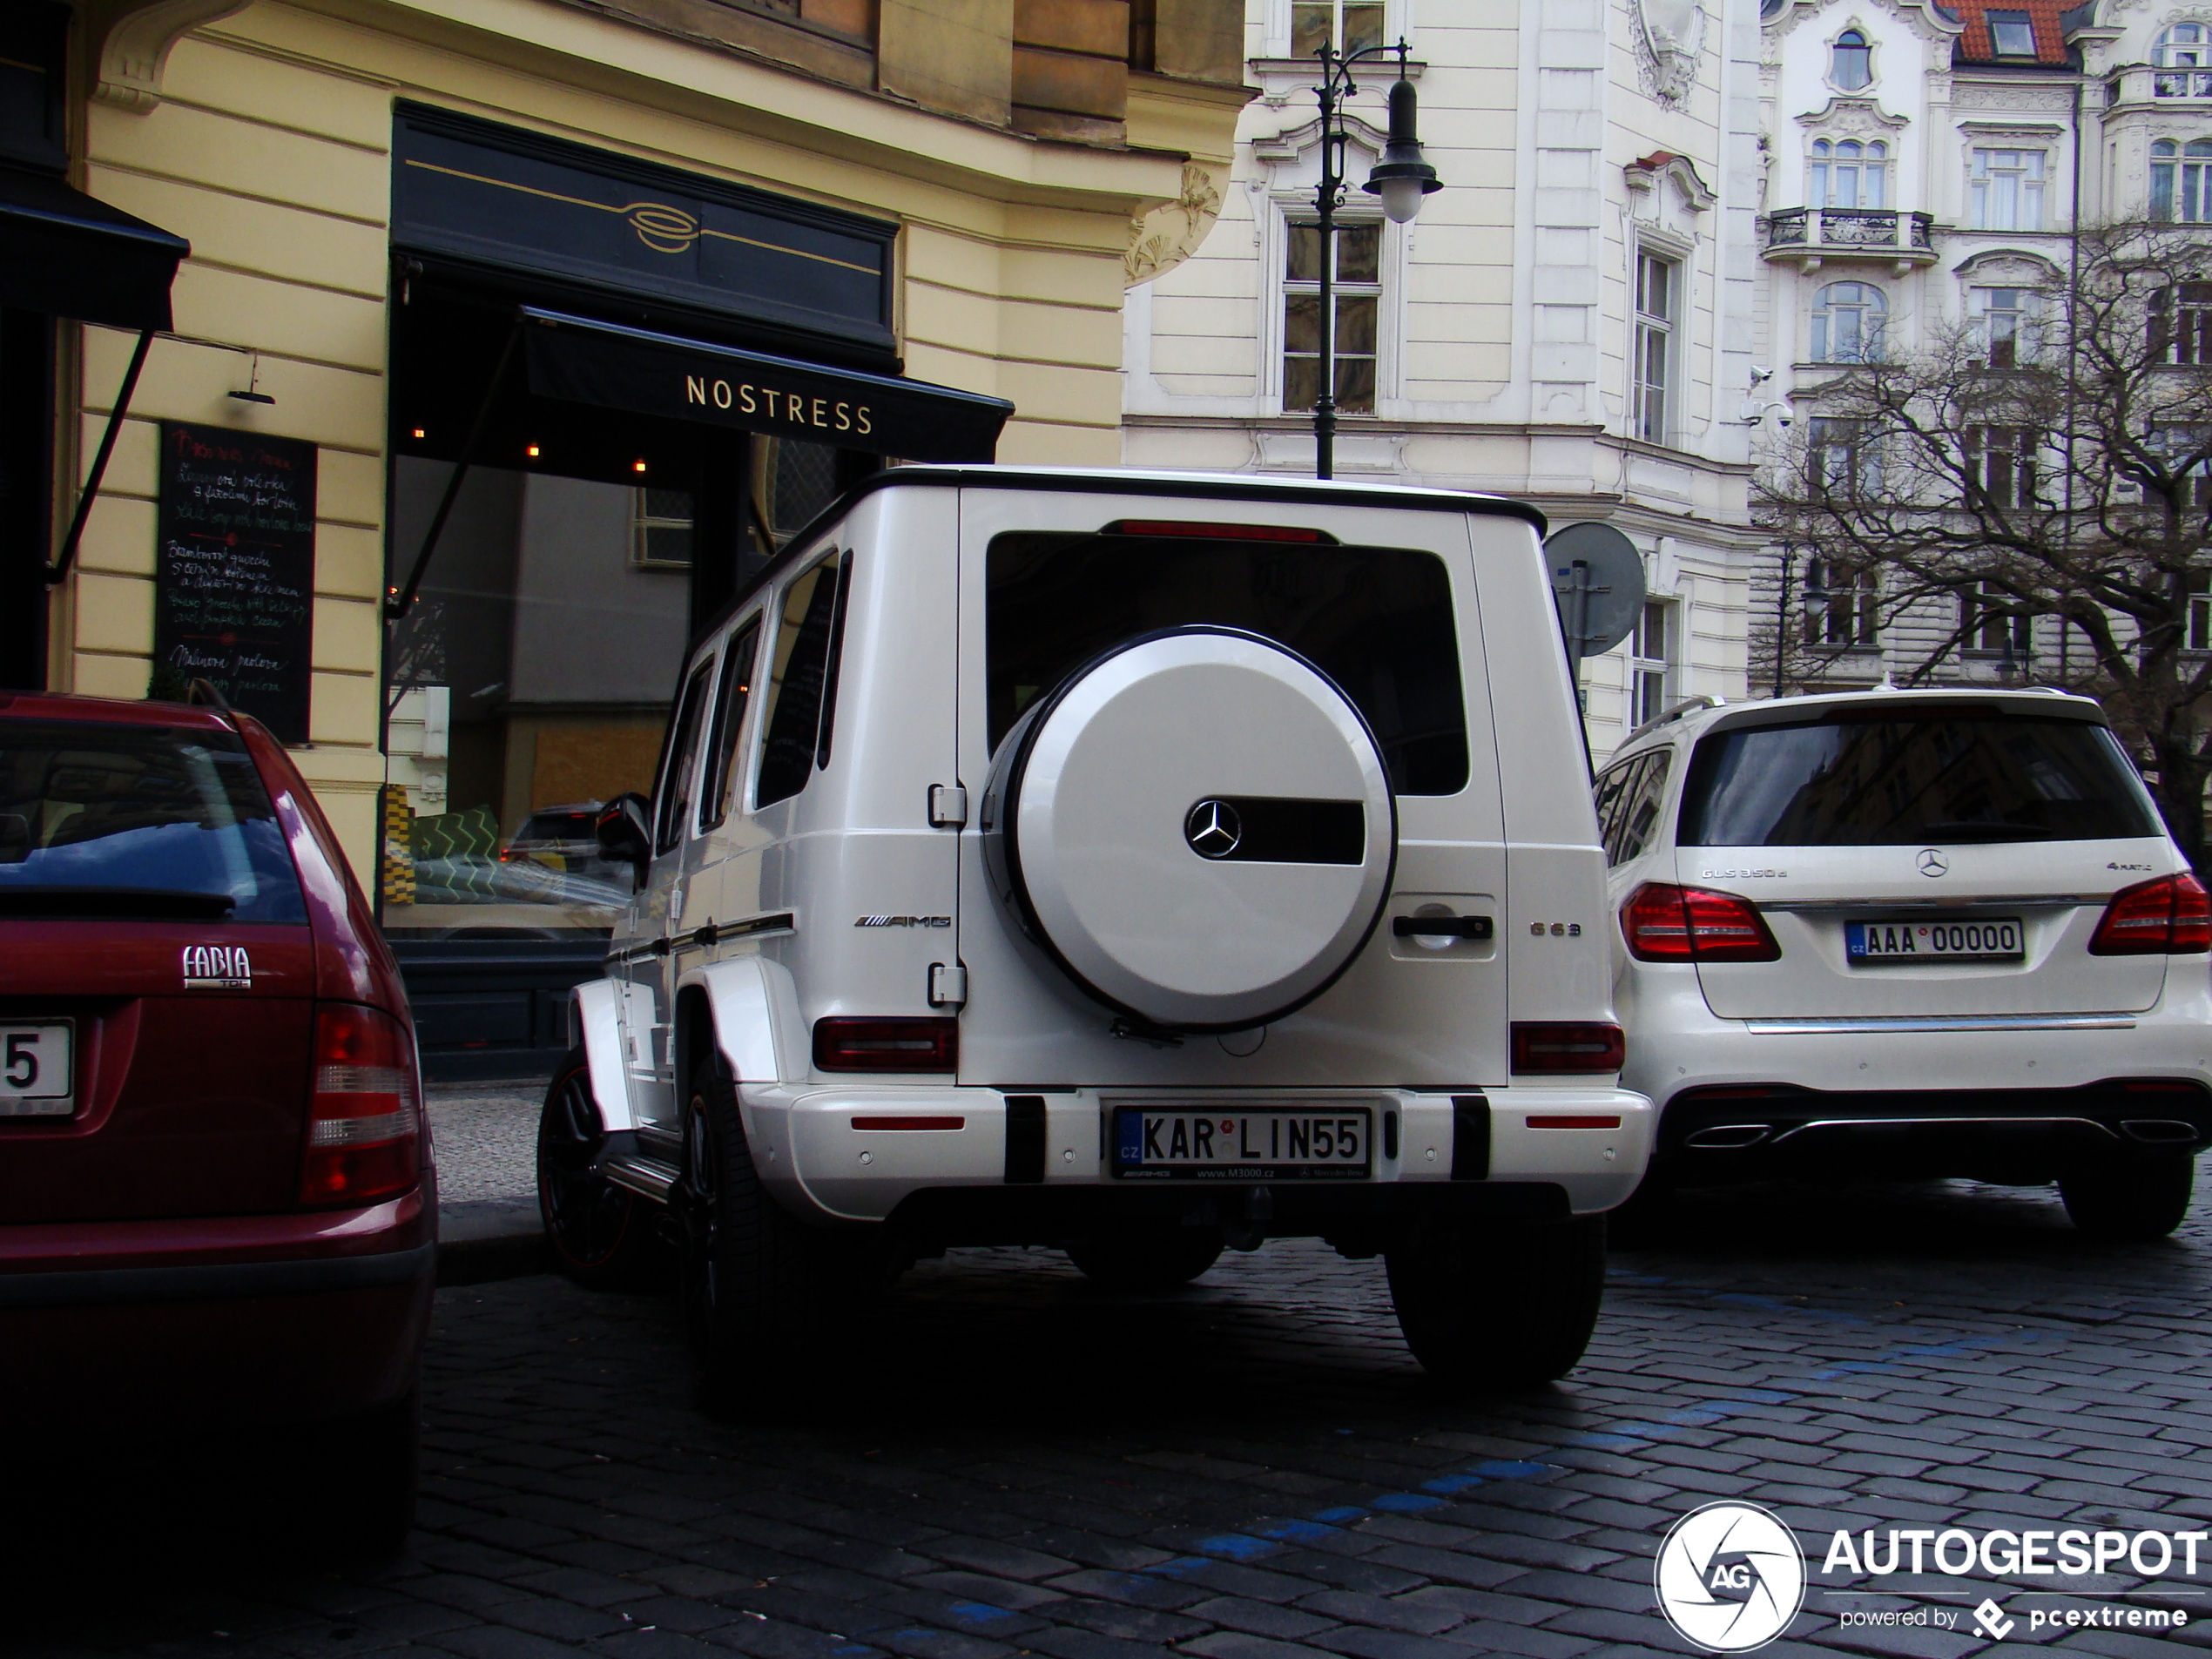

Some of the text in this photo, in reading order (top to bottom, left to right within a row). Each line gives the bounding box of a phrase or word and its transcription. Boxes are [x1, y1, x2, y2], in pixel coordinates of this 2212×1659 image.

[686, 374, 872, 435] NOSTRESS
[1702, 868, 1737, 879] GLS
[886, 915, 951, 927] AMG
[1851, 945, 1865, 954] CZ
[1868, 926, 1916, 954] AAA
[183, 945, 251, 978] FABIA
[1121, 1118, 1359, 1159] CZ KAR LIN55
[1197, 1169, 1276, 1178] www.M3000.cz
